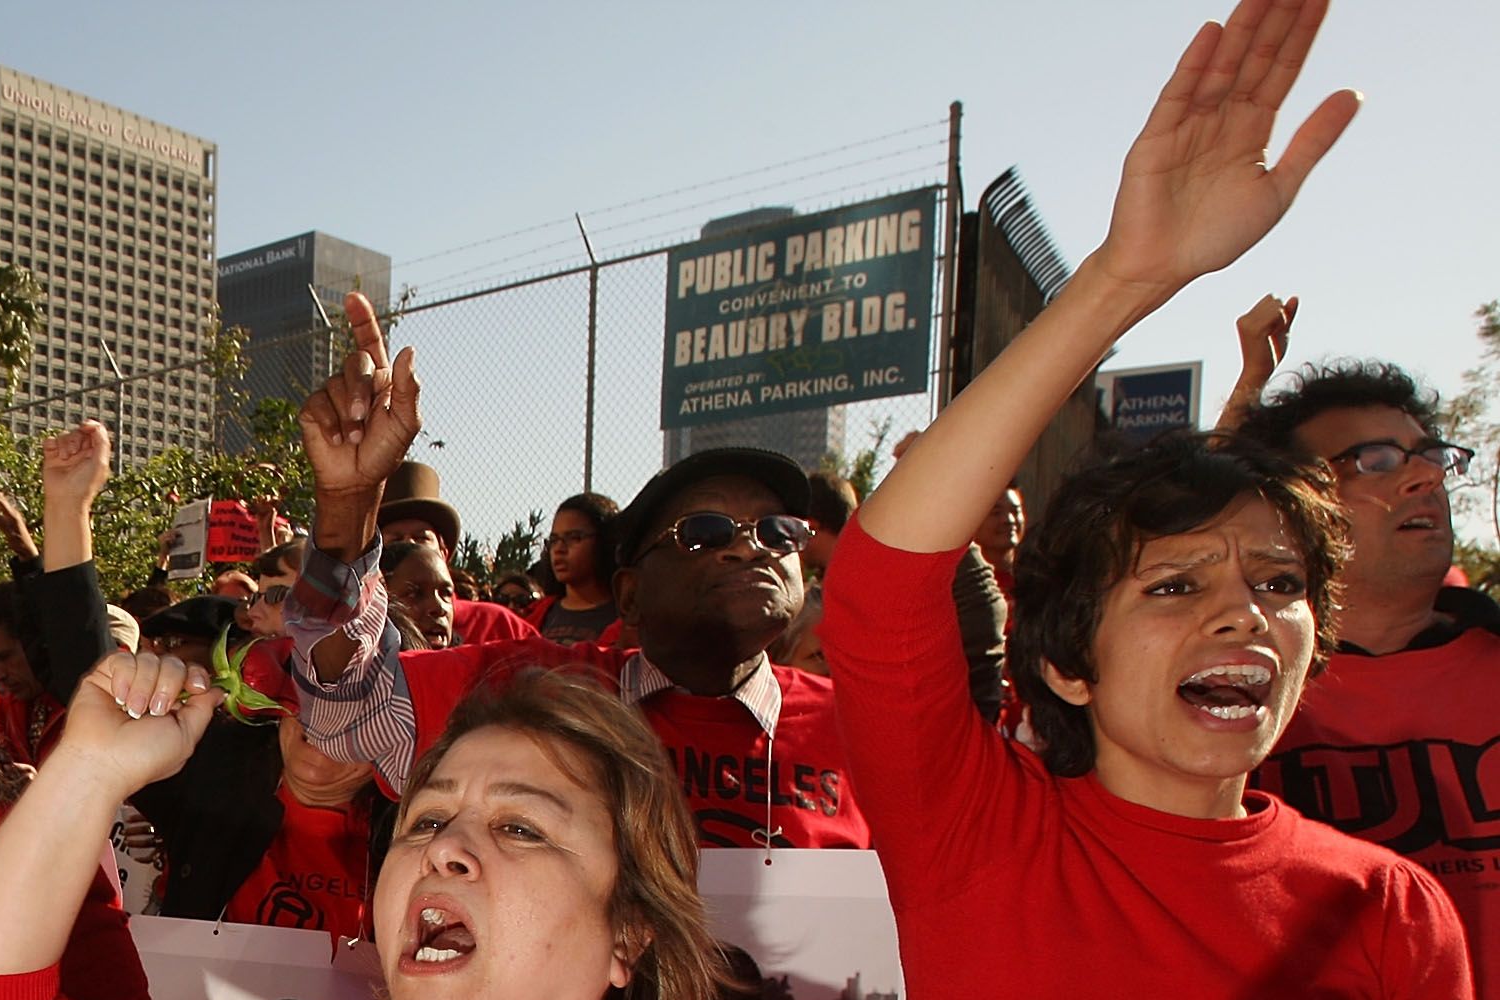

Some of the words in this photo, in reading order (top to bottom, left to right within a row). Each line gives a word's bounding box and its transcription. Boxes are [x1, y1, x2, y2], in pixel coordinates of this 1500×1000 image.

[2, 85, 53, 116] UNION
[57, 104, 94, 131] BANK
[99, 122, 114, 137] OF
[122, 127, 200, 168] CALIFORNIA
[217, 257, 265, 277] NATIONAL
[266, 246, 296, 264] BANK
[678, 240, 776, 299] PUBLIC
[785, 208, 922, 276] PARKING
[719, 279, 833, 315] CONVENIENT
[843, 272, 867, 290] TO
[674, 308, 808, 368] BEAUDRY
[822, 292, 916, 343] BLDG.
[679, 389, 752, 415] ATHENA
[760, 375, 854, 402] PARKING,
[863, 366, 904, 387] INC.
[684, 375, 743, 395] OPERATED
[1121, 393, 1186, 411] ATHENA
[1117, 411, 1185, 431] PARKING
